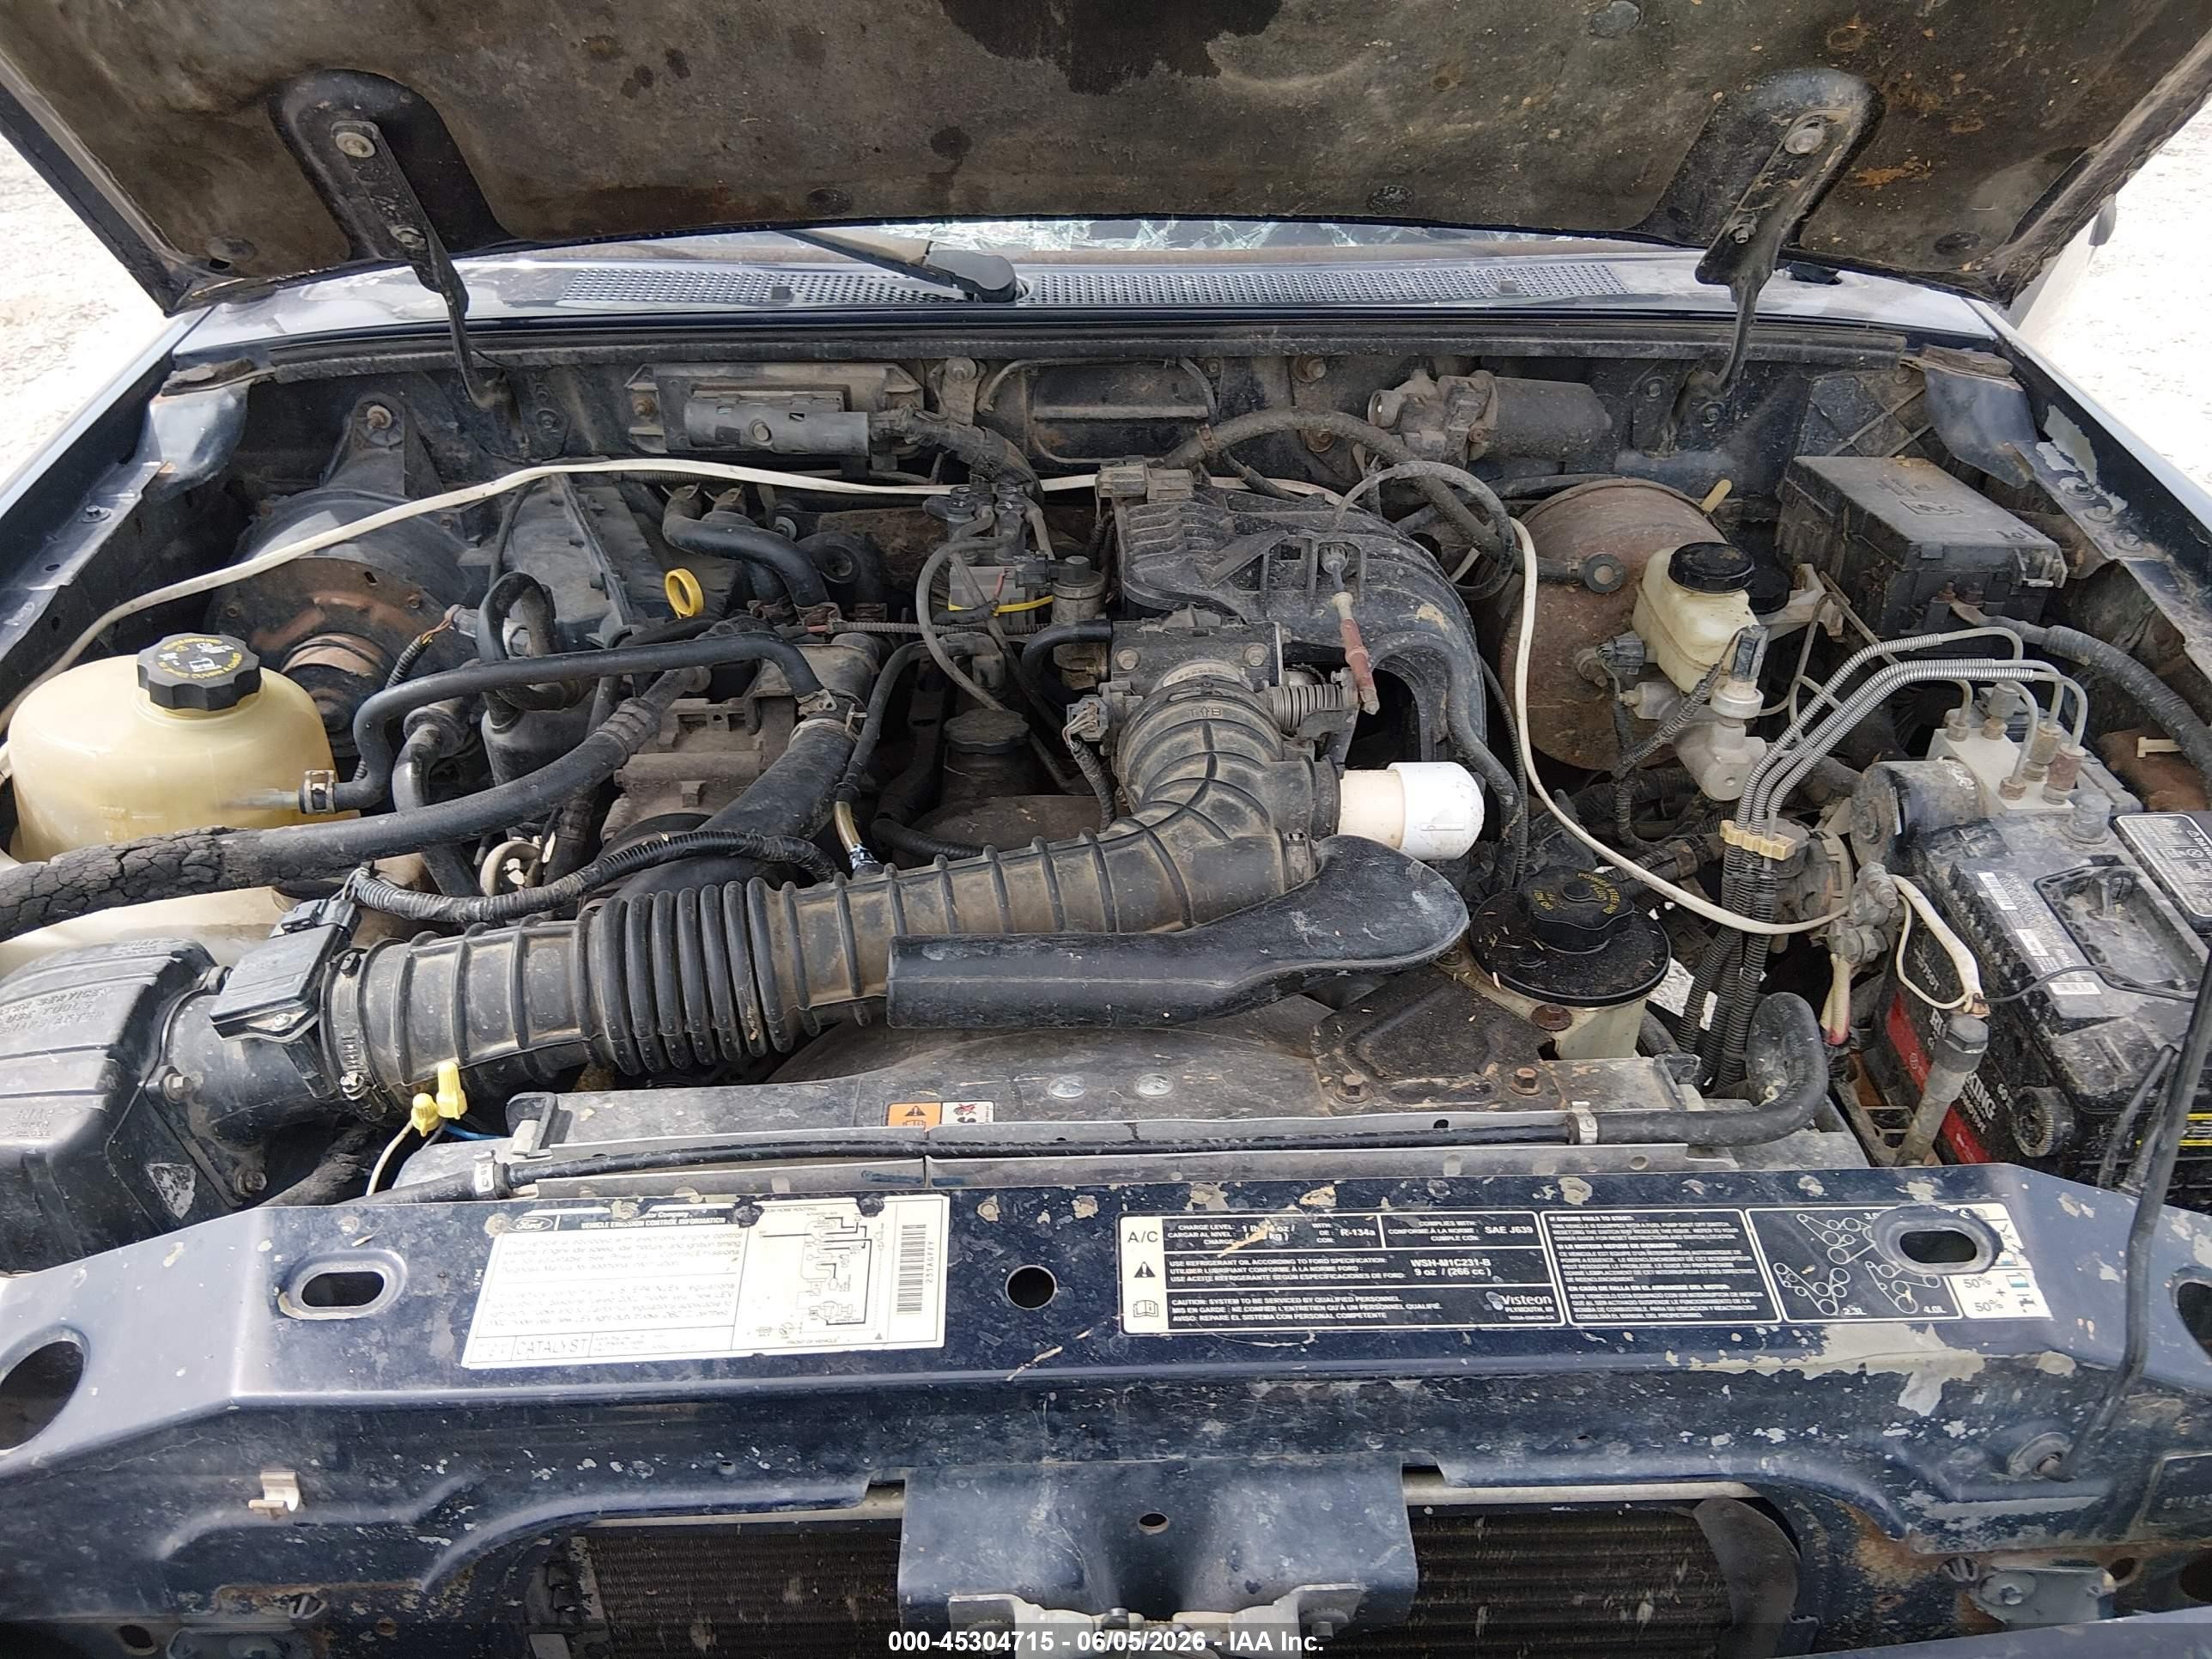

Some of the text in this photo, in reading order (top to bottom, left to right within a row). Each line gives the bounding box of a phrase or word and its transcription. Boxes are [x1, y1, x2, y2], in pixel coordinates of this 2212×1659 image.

[1578, 873, 1611, 887] POWER
[516, 1218, 544, 1231] Ford
[678, 1217, 726, 1225] INFORMATION
[1127, 1231, 1159, 1243] A/C
[1410, 1259, 1491, 1267] WSH-M1C231-B
[1448, 1267, 1470, 1277] (266
[1964, 1276, 1993, 1289] 50%
[1502, 1295, 1553, 1305] Visteon
[1975, 1300, 2004, 1312] 50%
[1923, 1305, 1948, 1314] 4.0L
[516, 1339, 589, 1355] CATALYST
